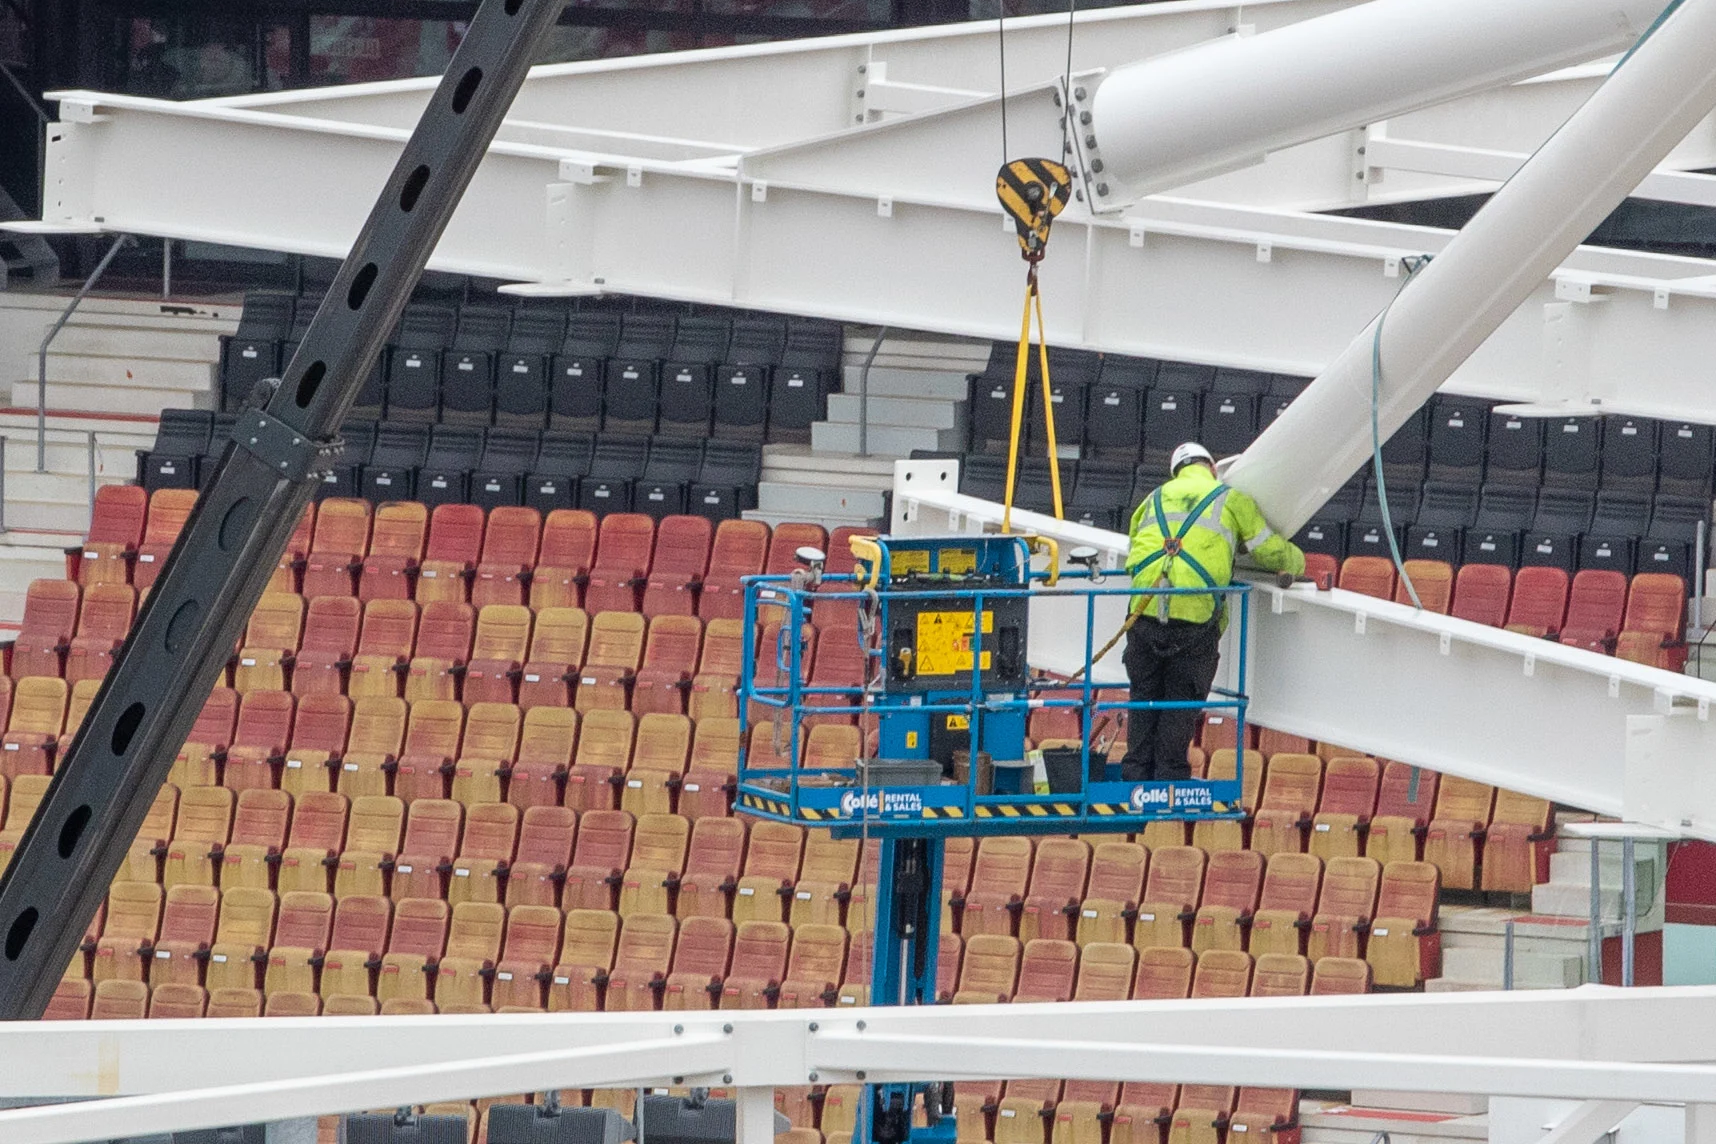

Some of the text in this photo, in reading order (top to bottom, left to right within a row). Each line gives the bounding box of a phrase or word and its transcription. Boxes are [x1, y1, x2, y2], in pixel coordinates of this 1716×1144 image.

[1175, 788, 1211, 797] RENTAL
[885, 793, 921, 803] RENTAL
[1131, 785, 1168, 810] Collé
[1175, 796, 1212, 805] & SALES
[885, 802, 922, 811] & SALES
